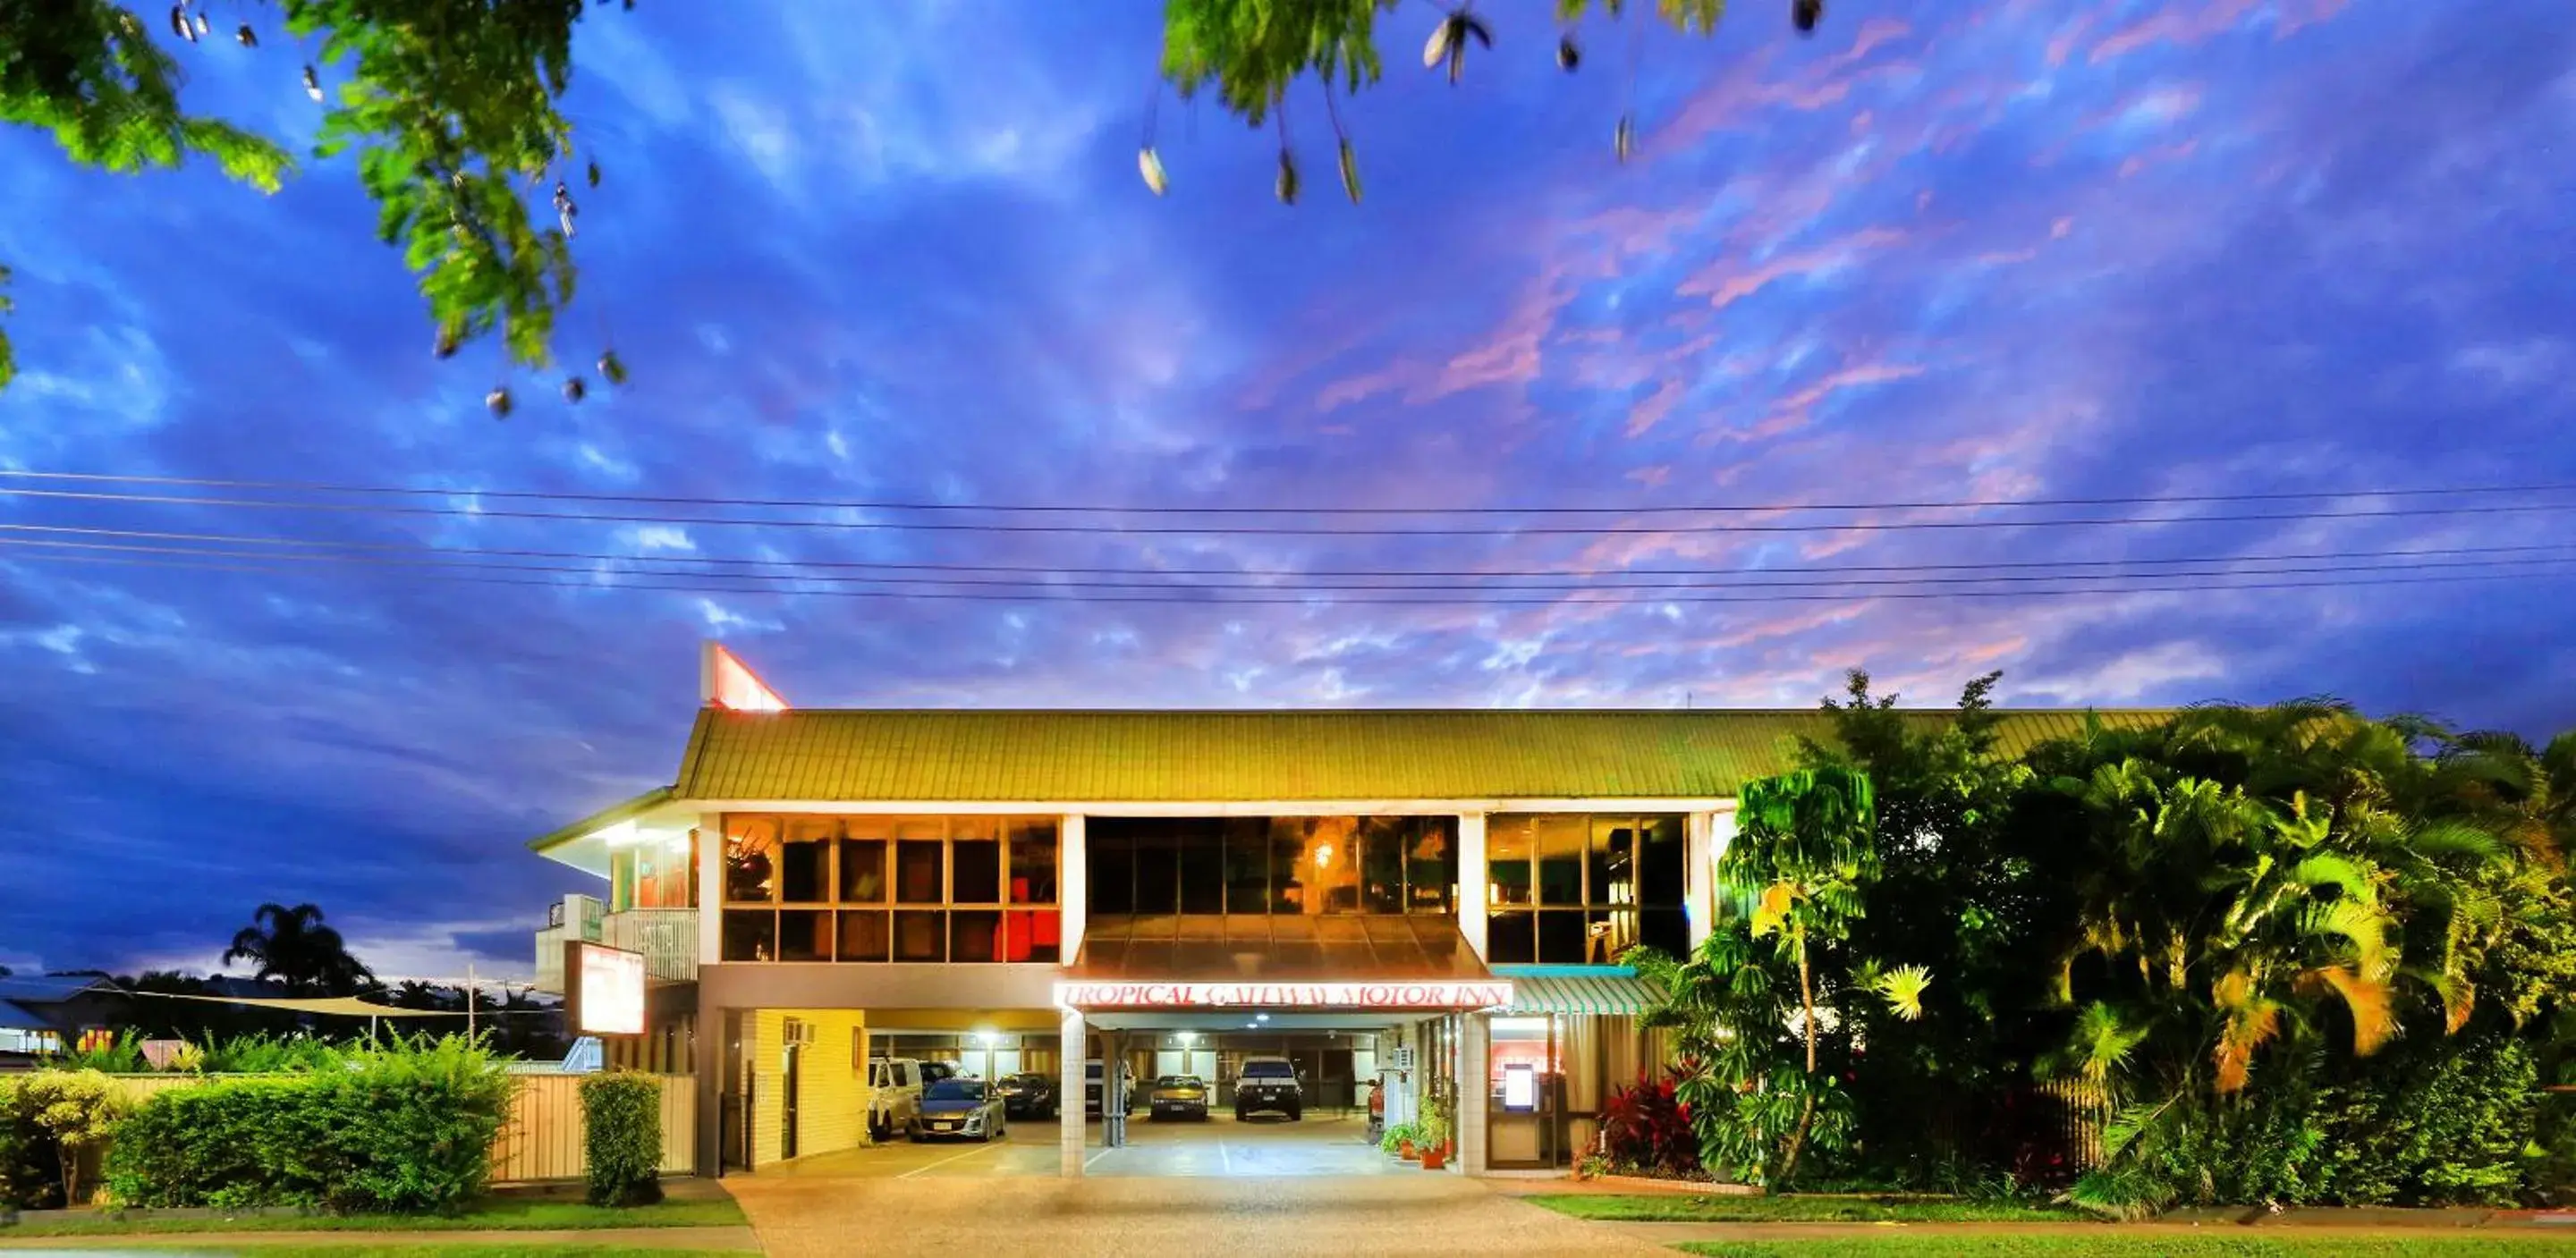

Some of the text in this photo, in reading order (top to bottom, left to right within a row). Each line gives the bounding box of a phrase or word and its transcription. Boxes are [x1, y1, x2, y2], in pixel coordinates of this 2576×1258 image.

[1064, 985, 1196, 1004] TROPICAL
[1340, 986, 1445, 1005] MOTOR
[1454, 986, 1509, 1005] INN
